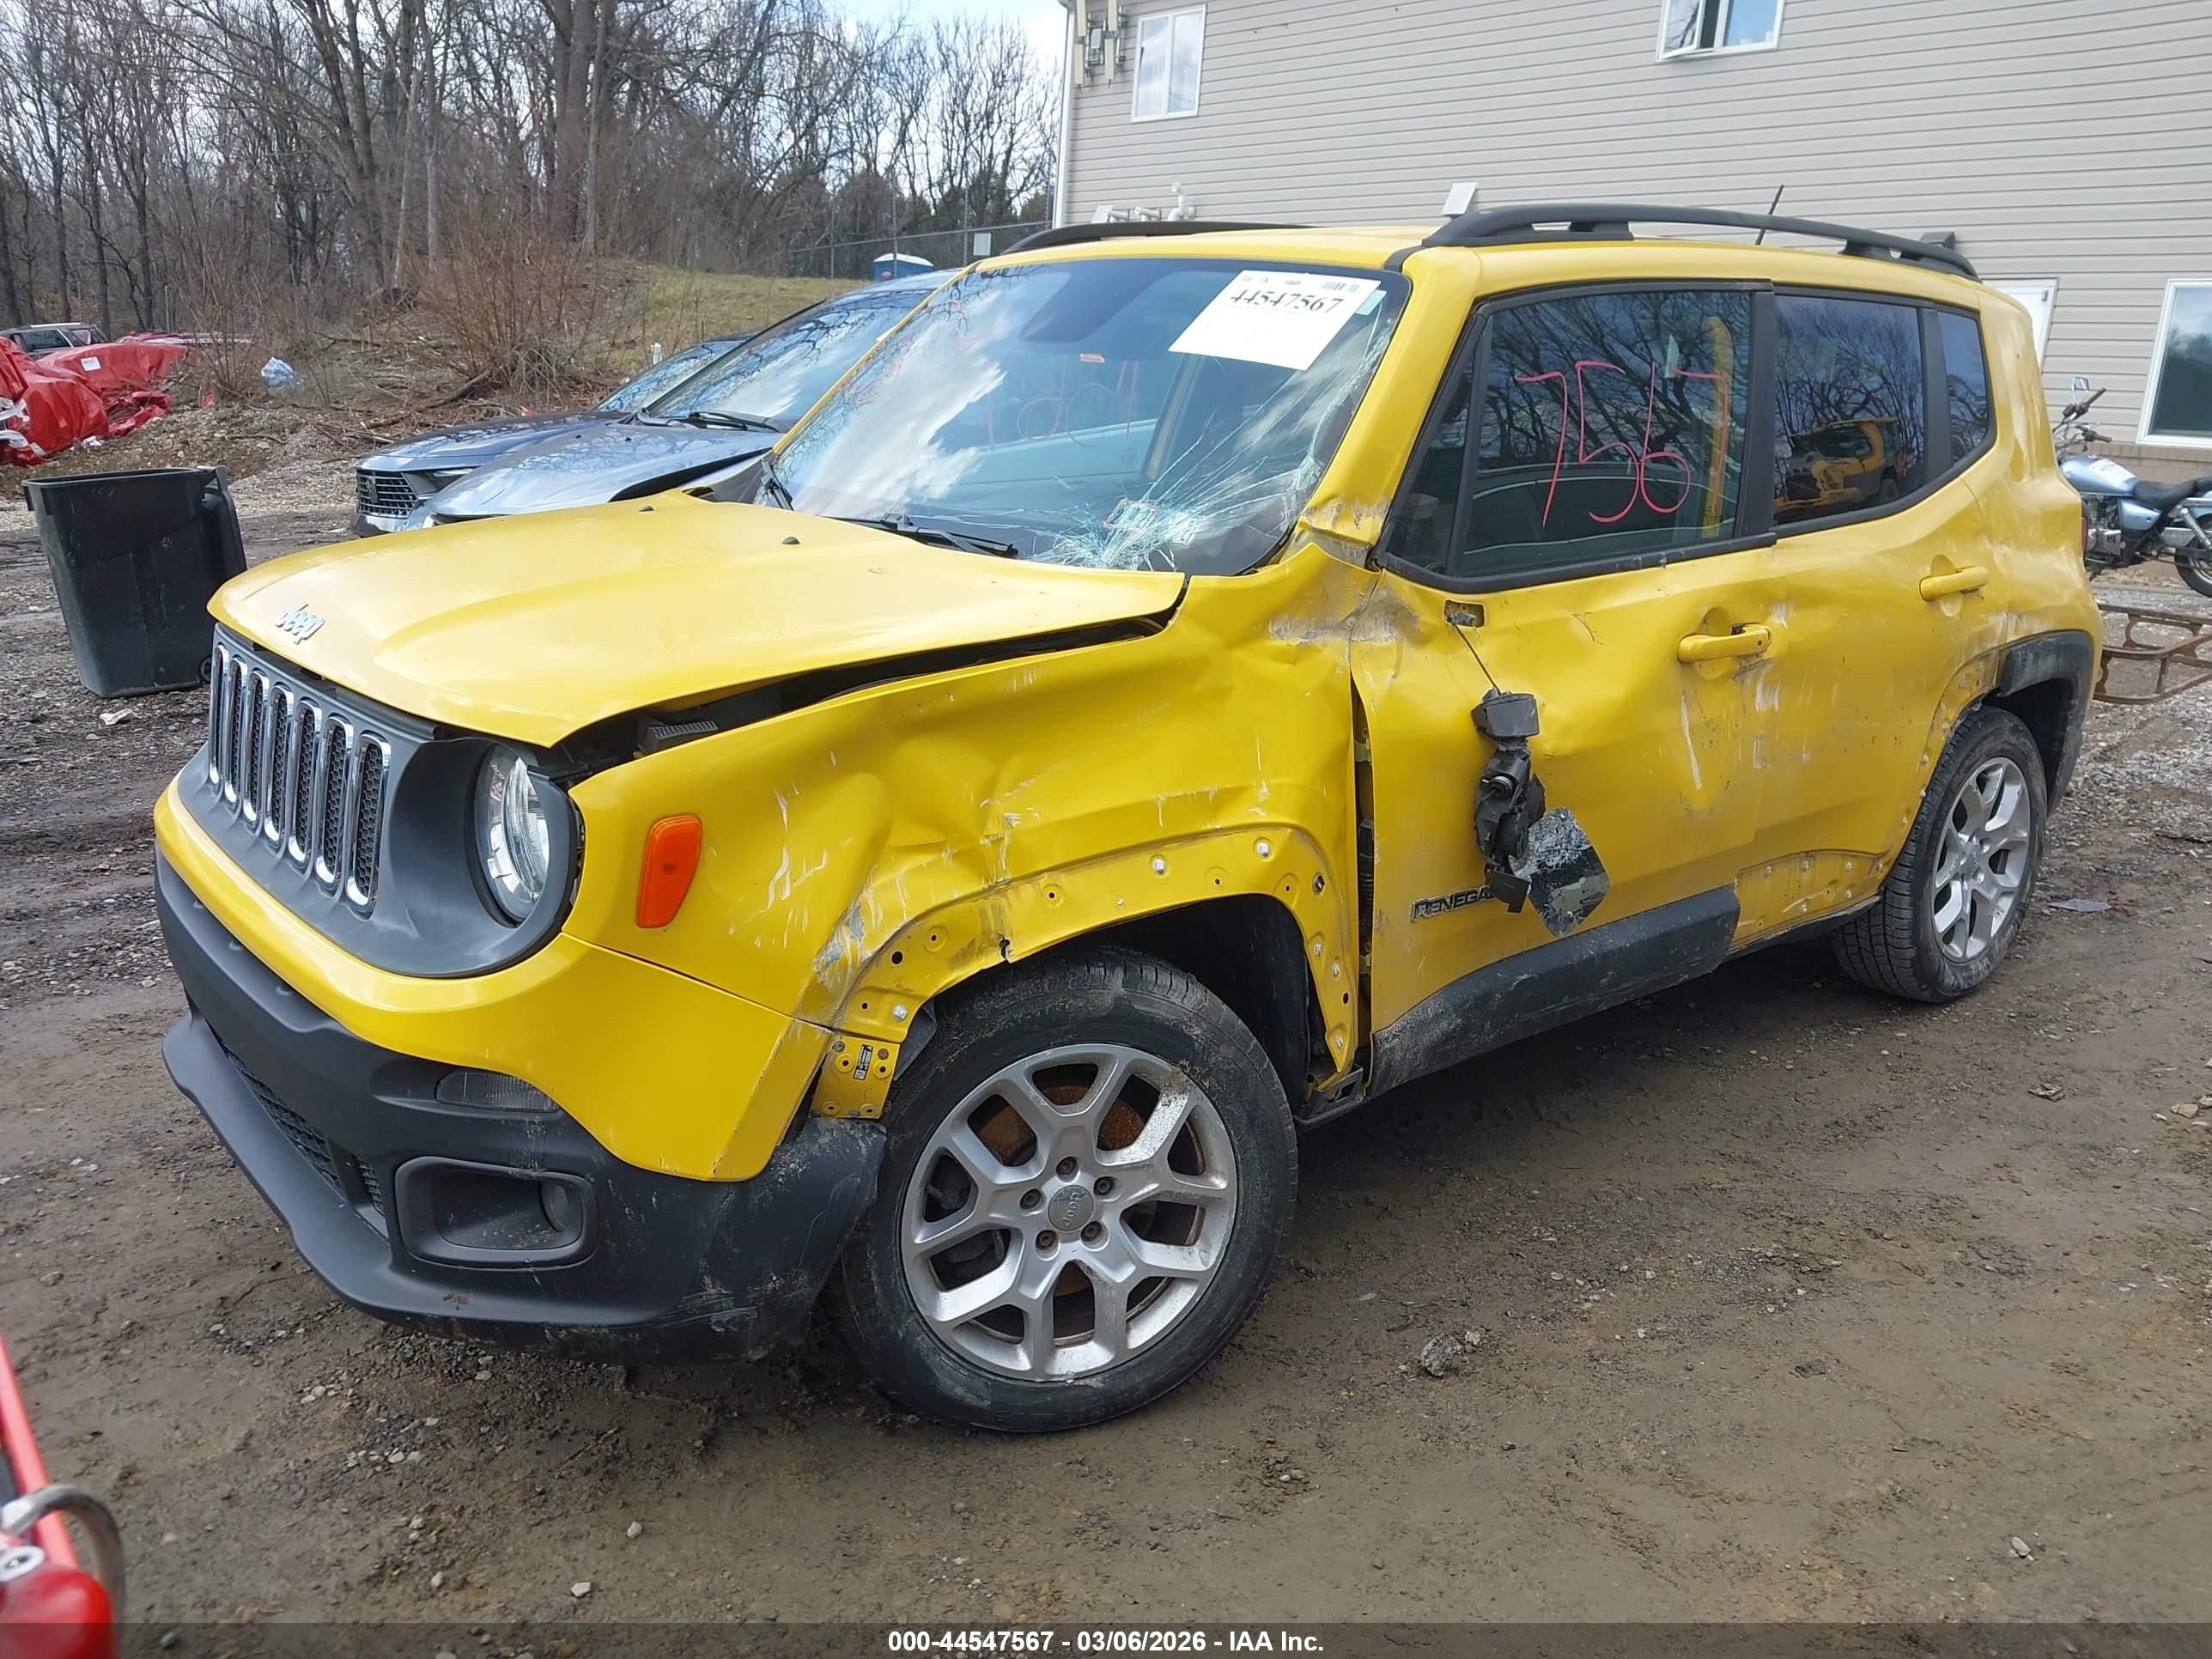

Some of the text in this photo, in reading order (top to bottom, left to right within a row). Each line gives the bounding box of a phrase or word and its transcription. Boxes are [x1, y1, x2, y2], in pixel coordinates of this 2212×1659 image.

[1231, 289, 1345, 313] 44547567
[1514, 360, 1729, 528] 7567
[275, 602, 325, 645] Jeep
[1410, 884, 1492, 922] RENEGA
